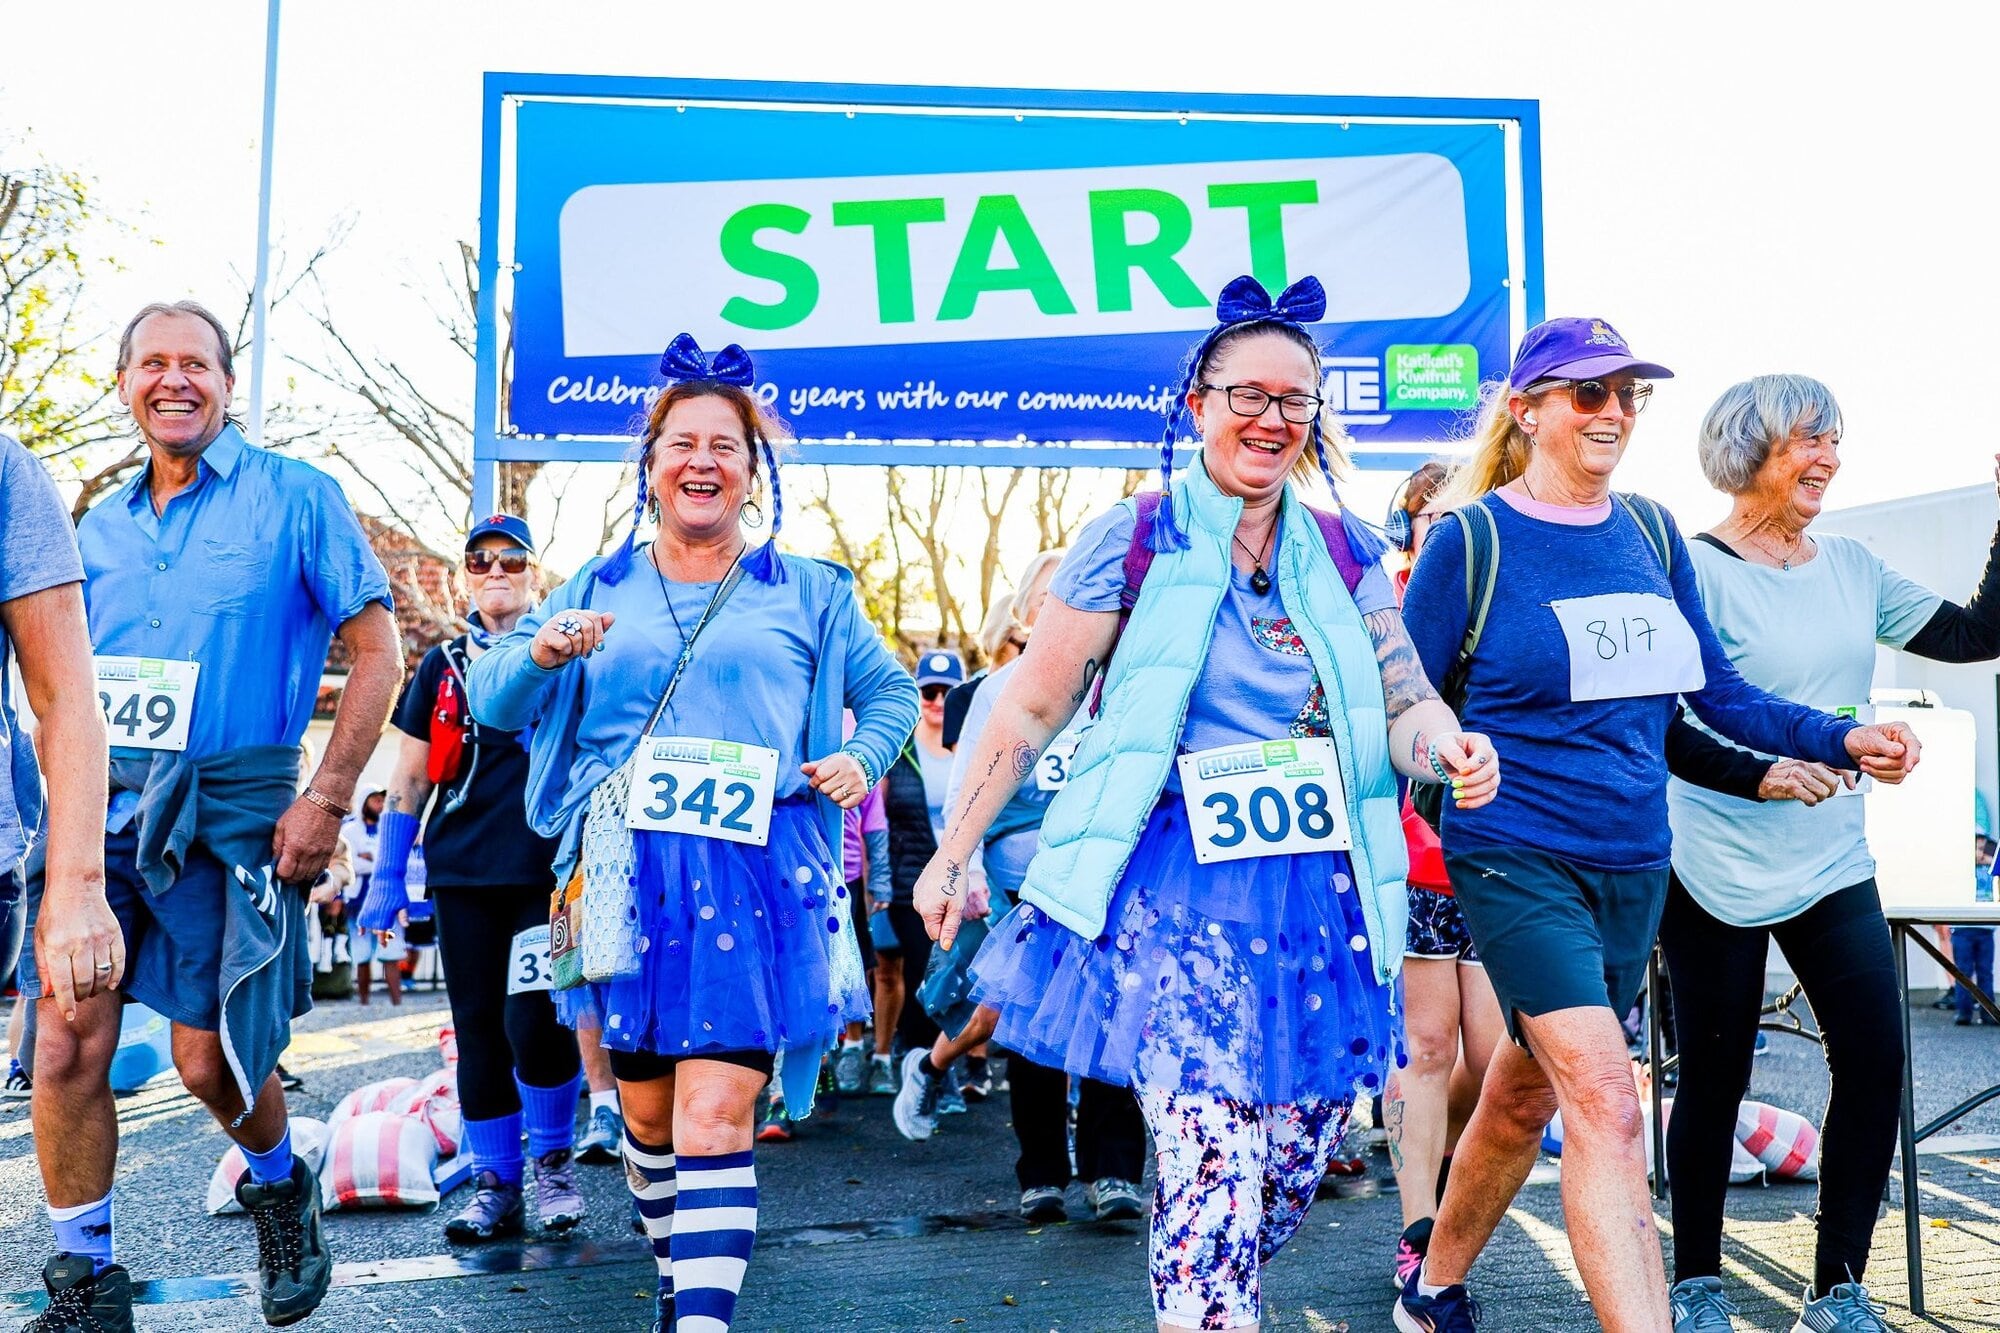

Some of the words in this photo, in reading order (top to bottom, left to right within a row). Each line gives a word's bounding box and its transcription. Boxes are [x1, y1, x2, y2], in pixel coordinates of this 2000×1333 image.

[719, 180, 1319, 330] START
[1397, 369, 1461, 384] Kiwifruit
[547, 376, 658, 404] Celebra
[790, 386, 866, 416] years
[877, 380, 949, 410] with
[955, 390, 1008, 409] our
[1017, 384, 1177, 415] communit
[1396, 384, 1469, 402] Company.
[1586, 617, 1658, 660] 817
[98, 664, 137, 678] HUME
[656, 743, 709, 761] HUME
[1202, 753, 1263, 775] HUME
[643, 772, 755, 833] 342
[1202, 783, 1334, 848] 308
